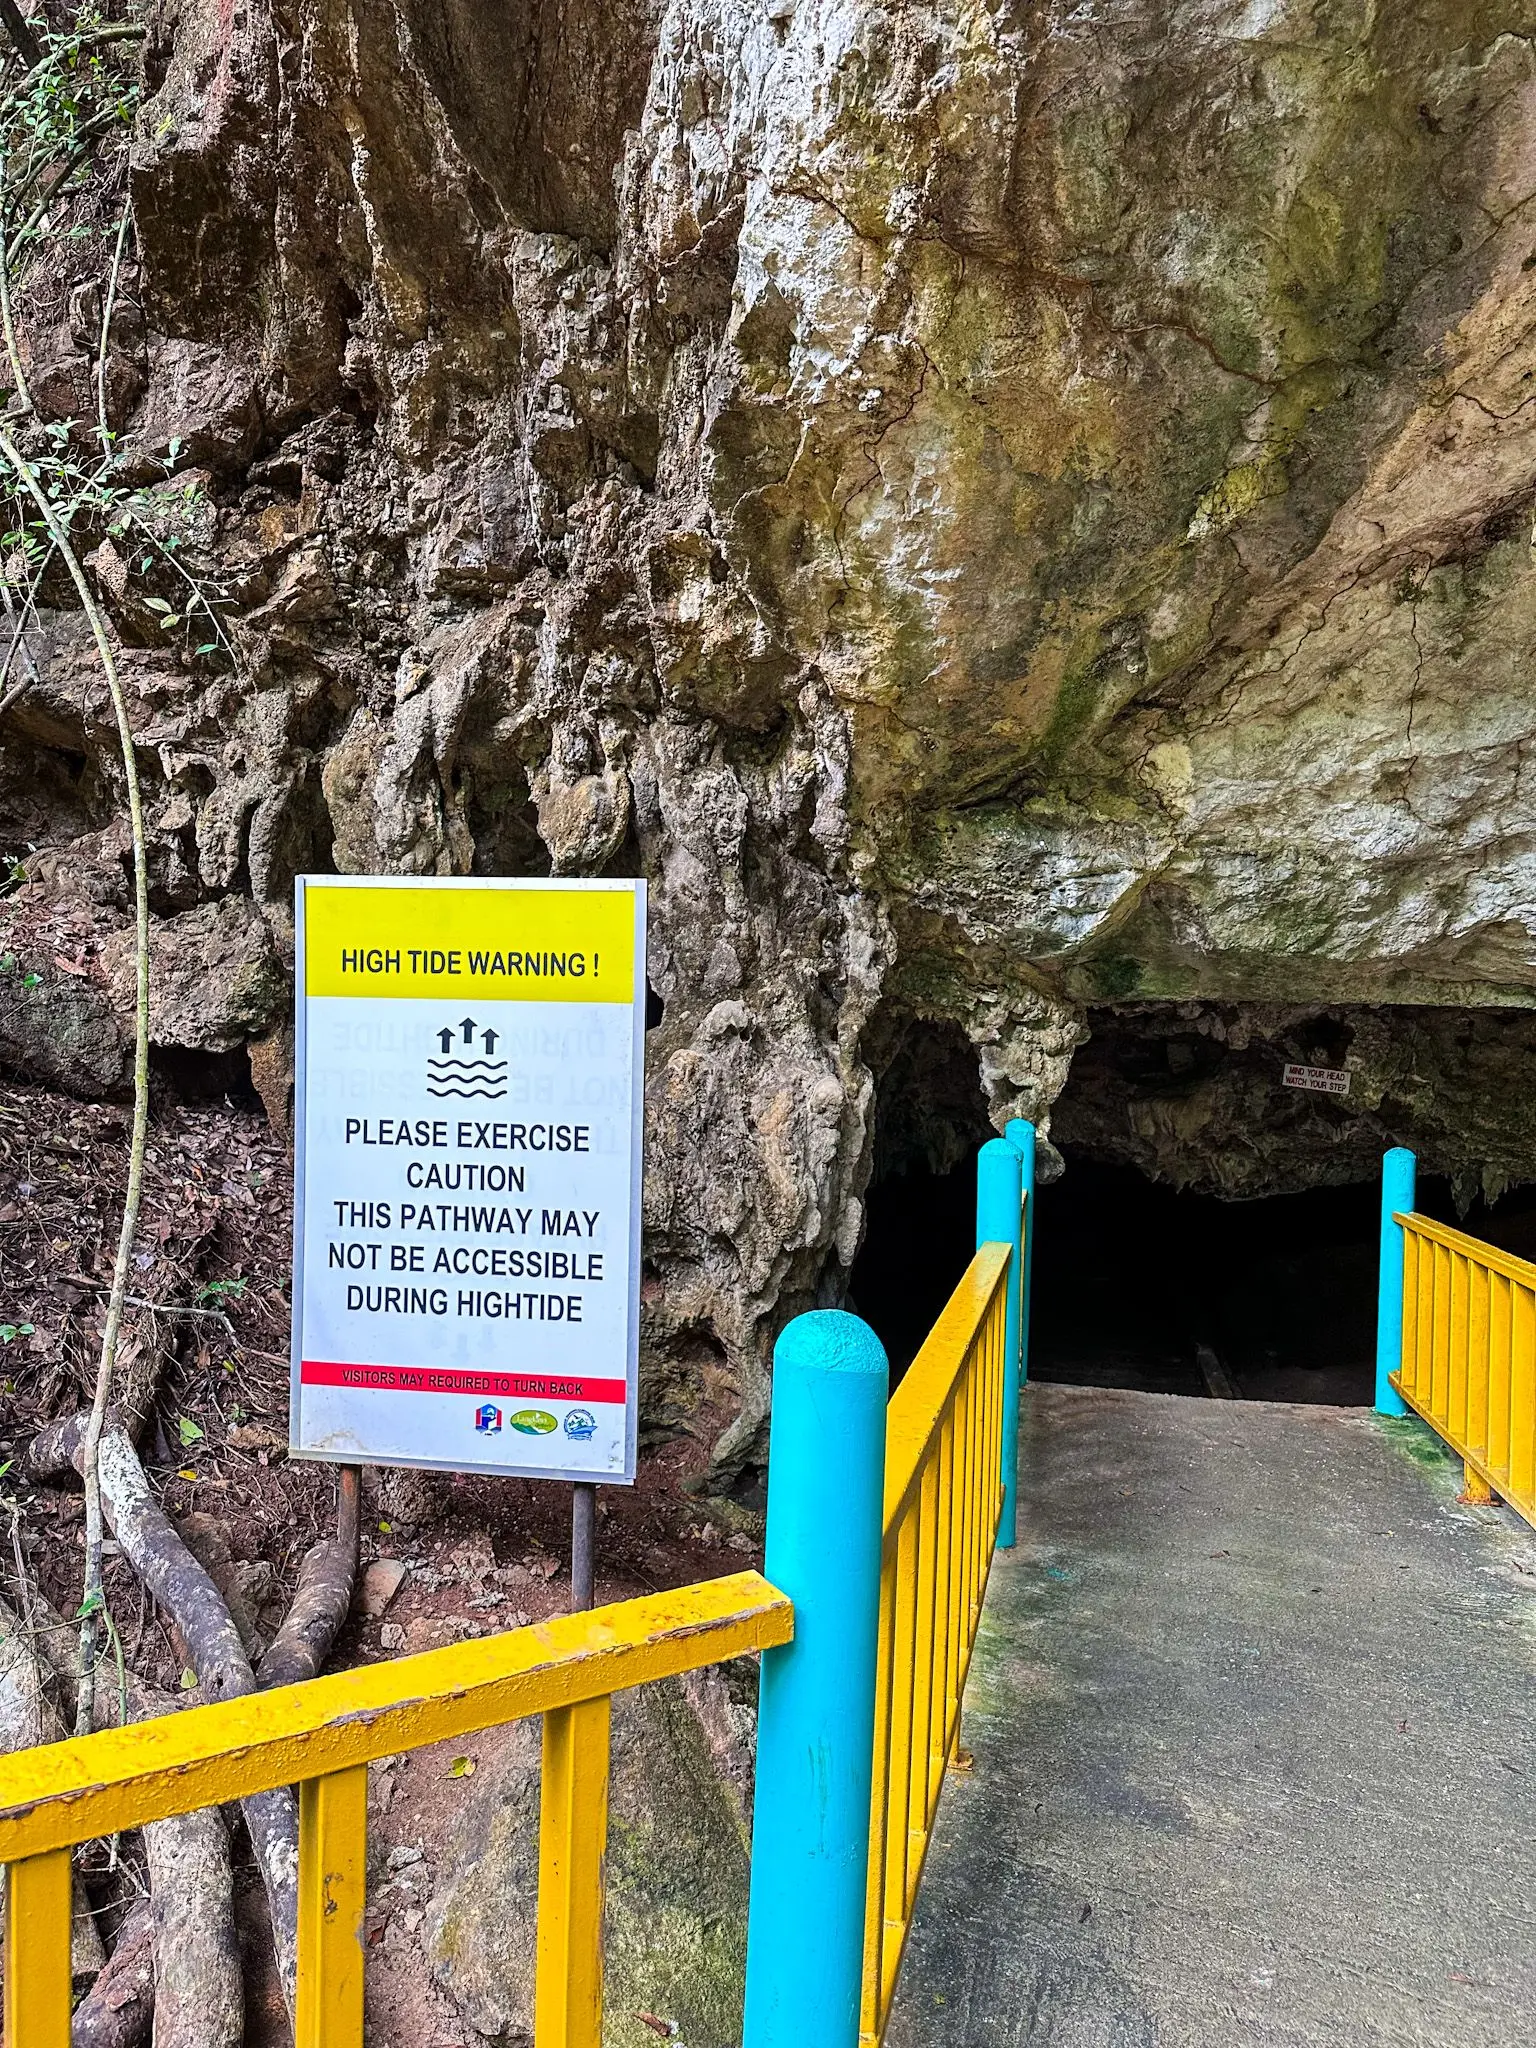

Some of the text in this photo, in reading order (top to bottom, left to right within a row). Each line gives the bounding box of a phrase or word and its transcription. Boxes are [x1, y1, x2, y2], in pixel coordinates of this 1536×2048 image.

[342, 949, 400, 974] HIGH
[407, 950, 462, 975] TIDE
[468, 951, 585, 977] WARNING
[1285, 1075, 1347, 1092] WATCH YOUR STEP
[1289, 1066, 1346, 1082] MIND YOUR HEAD
[345, 1118, 448, 1147] PLEASE
[457, 1122, 590, 1152] EXERCISE
[406, 1162, 525, 1192] CAUTION
[333, 1201, 600, 1238] THIS PATHWAY MAY
[329, 1242, 603, 1281] NOT BE ACCESSIBLE
[347, 1285, 582, 1322] DURING HIGHTIDE
[342, 1369, 583, 1396] VISITORS MAY REQUIRED TO TURN BACK
